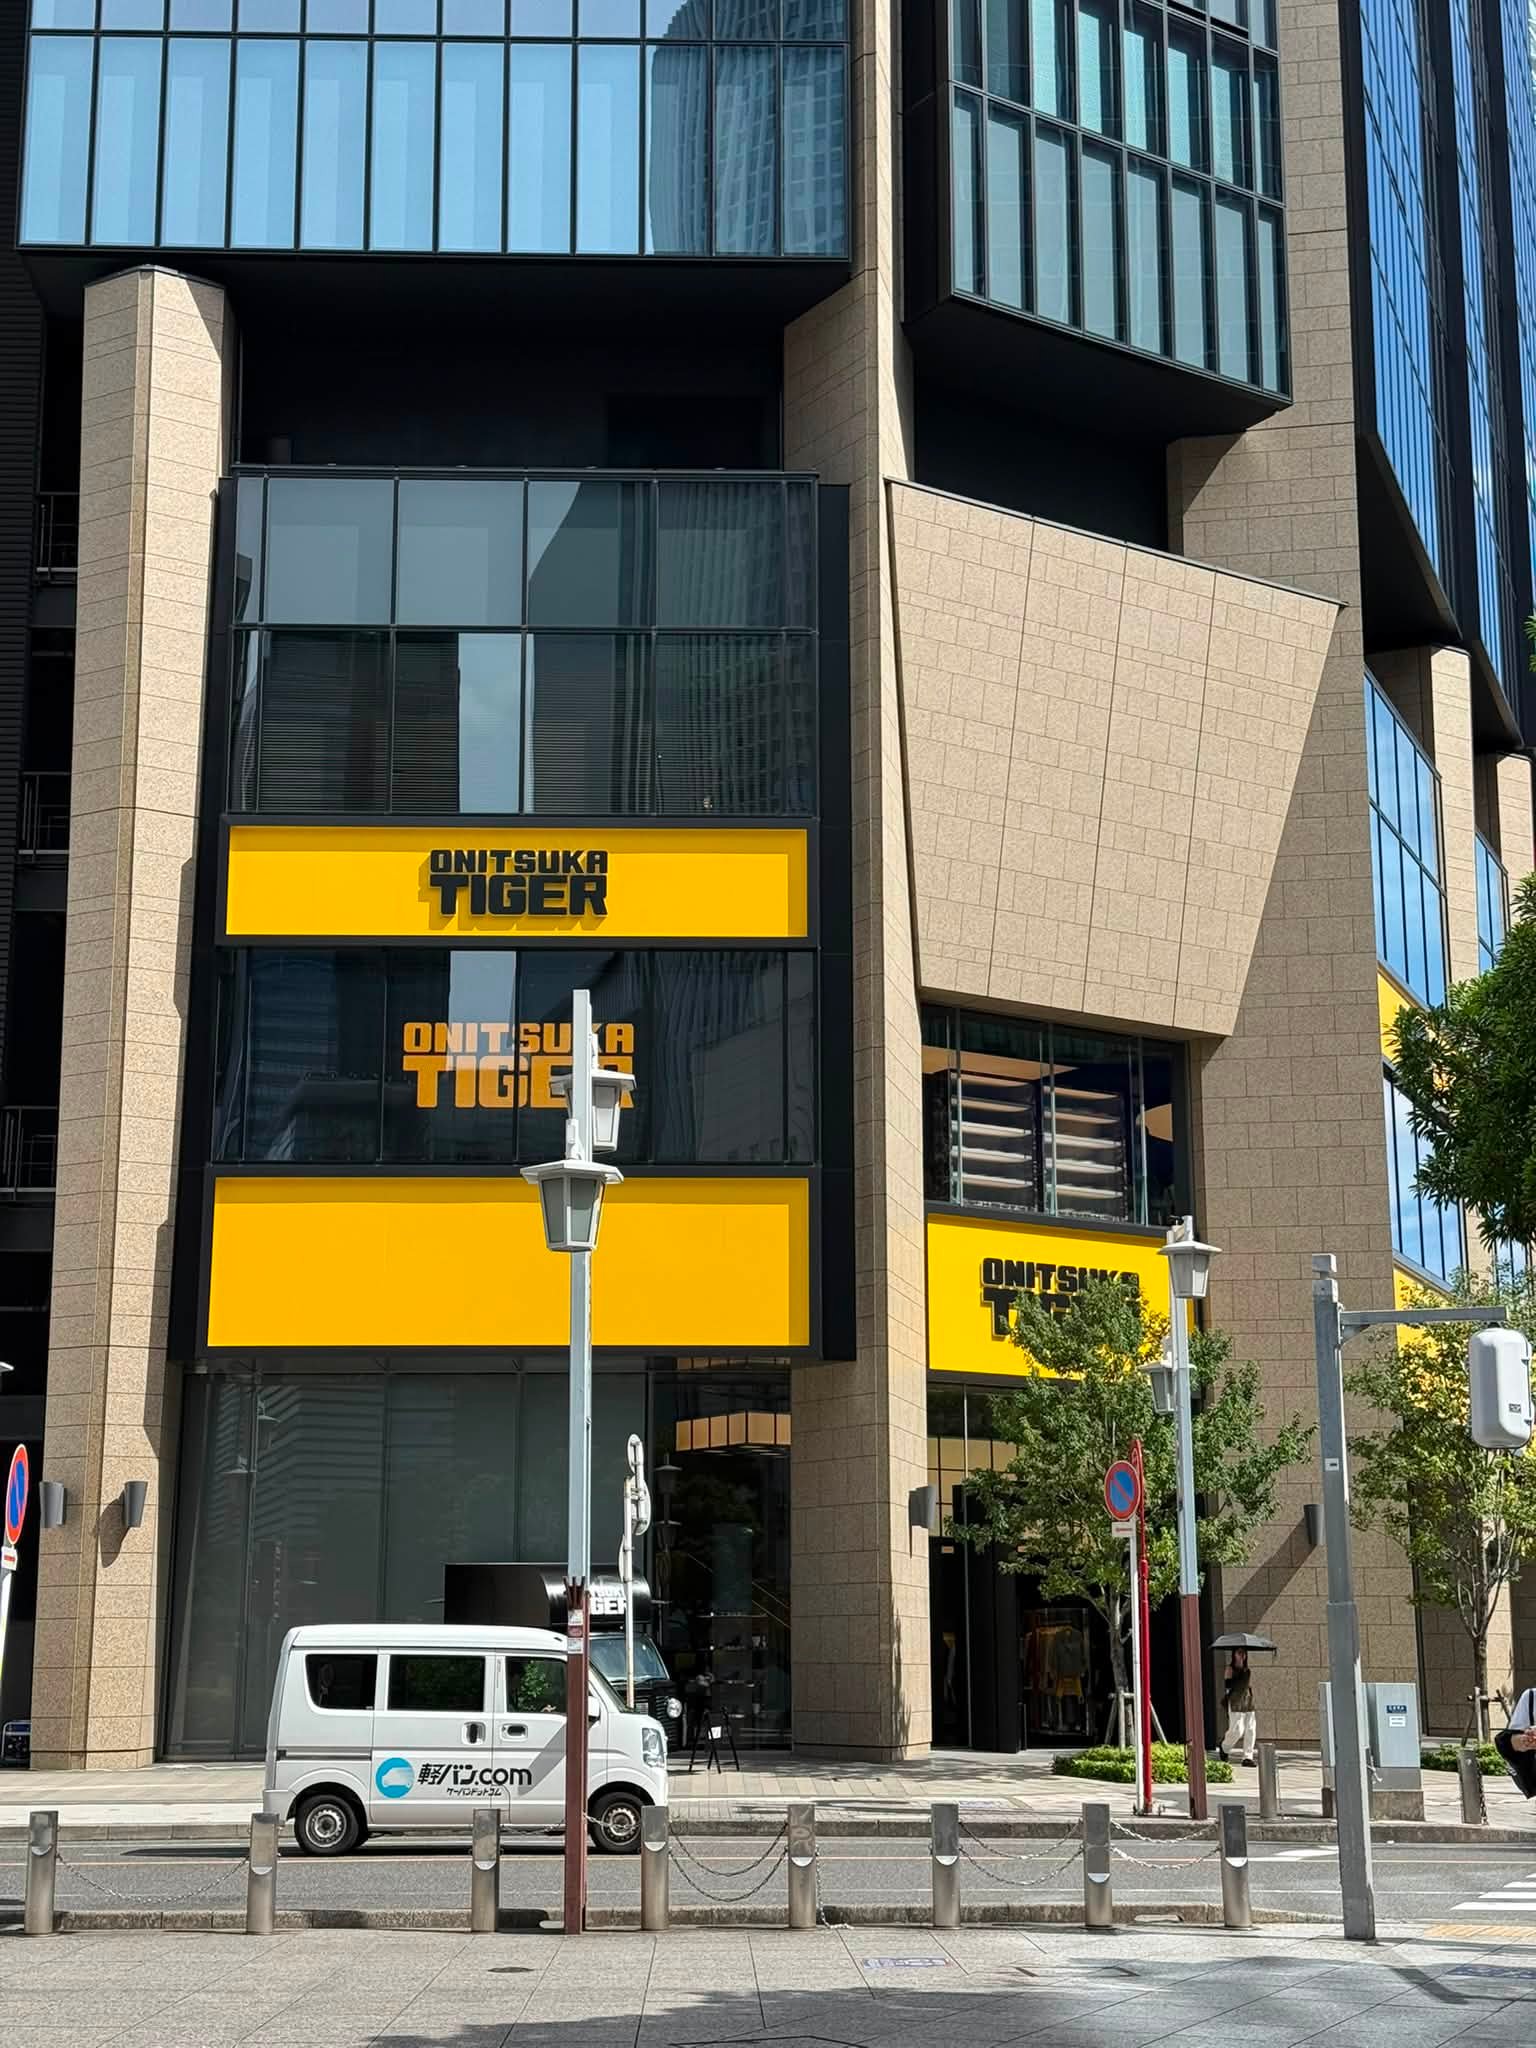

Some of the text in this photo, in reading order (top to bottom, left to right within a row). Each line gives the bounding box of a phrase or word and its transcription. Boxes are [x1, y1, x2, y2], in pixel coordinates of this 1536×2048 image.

[430, 850, 608, 873] ONITSUKA
[430, 875, 608, 915] TIGER
[403, 1022, 634, 1053] ONITSUA
[417, 1763, 532, 1785] 軽バン.com
